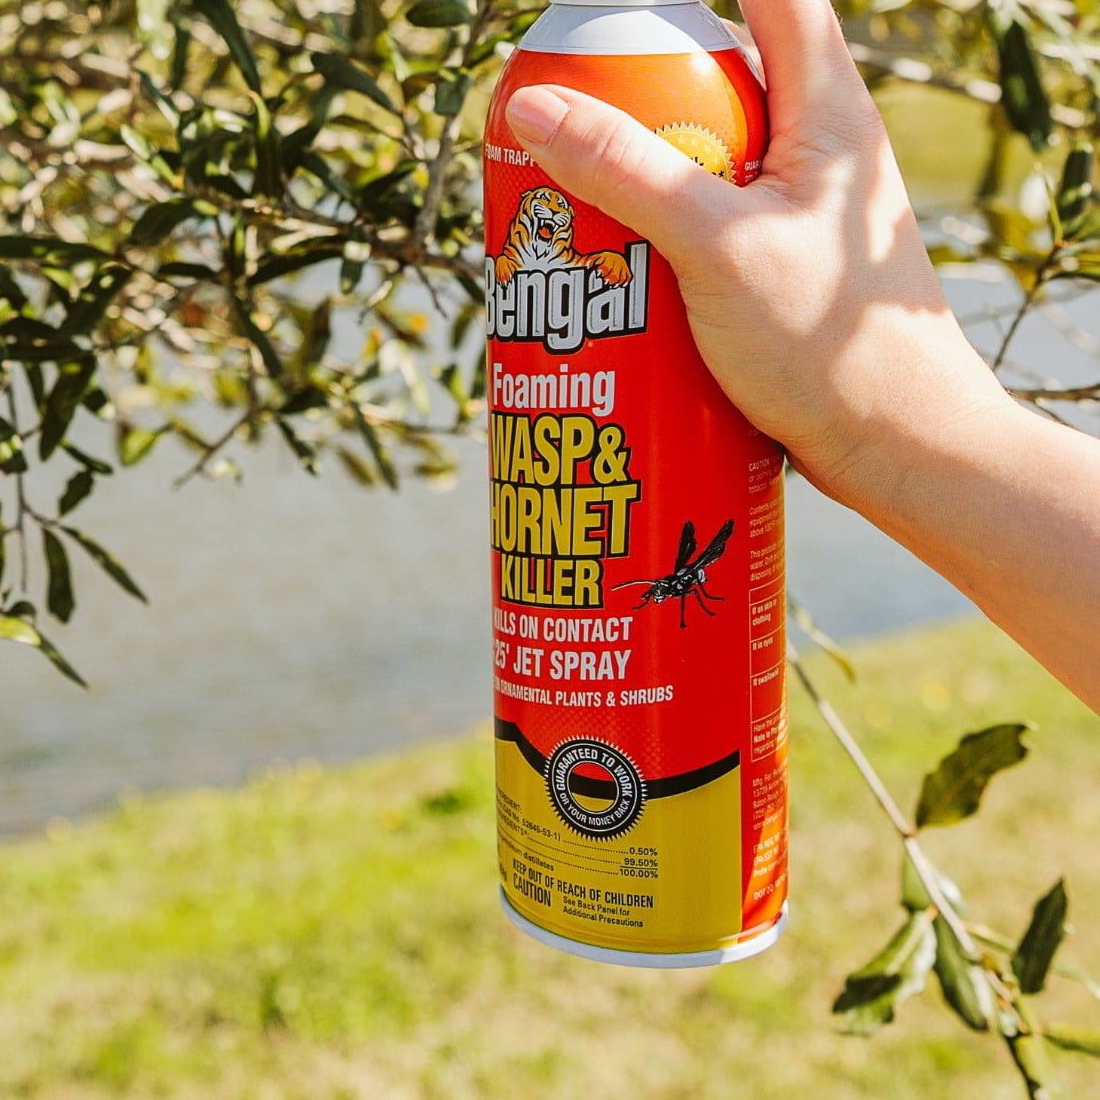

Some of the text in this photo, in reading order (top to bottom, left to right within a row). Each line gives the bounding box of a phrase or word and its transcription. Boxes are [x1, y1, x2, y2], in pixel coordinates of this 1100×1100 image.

[485, 240, 649, 352] Bengal
[493, 363, 616, 417] Foaming
[490, 482, 638, 556] HORNET
[501, 553, 600, 606] KILLER
[519, 614, 539, 640] ON
[543, 616, 634, 643] CONTACT
[513, 645, 545, 677] JET
[549, 649, 632, 681] SPRAY
[500, 679, 552, 705] ORNAMENTAL
[555, 690, 602, 708] PLANTS
[606, 691, 616, 707] &
[620, 684, 674, 707] SHRUBS
[555, 748, 633, 798] GUARANTEED TO WORK
[560, 792, 631, 826] OR YOUR MONEY BACK
[513, 858, 527, 876] KEEP
[528, 867, 543, 884] OUT
[545, 875, 555, 889] OF
[557, 879, 586, 899] REACH
[589, 888, 602, 902] OF
[604, 891, 654, 909] CHILDREN
[513, 872, 552, 908] CAUTION
[563, 896, 631, 917] See Back Panel for
[563, 905, 644, 928] Additional Precautions
